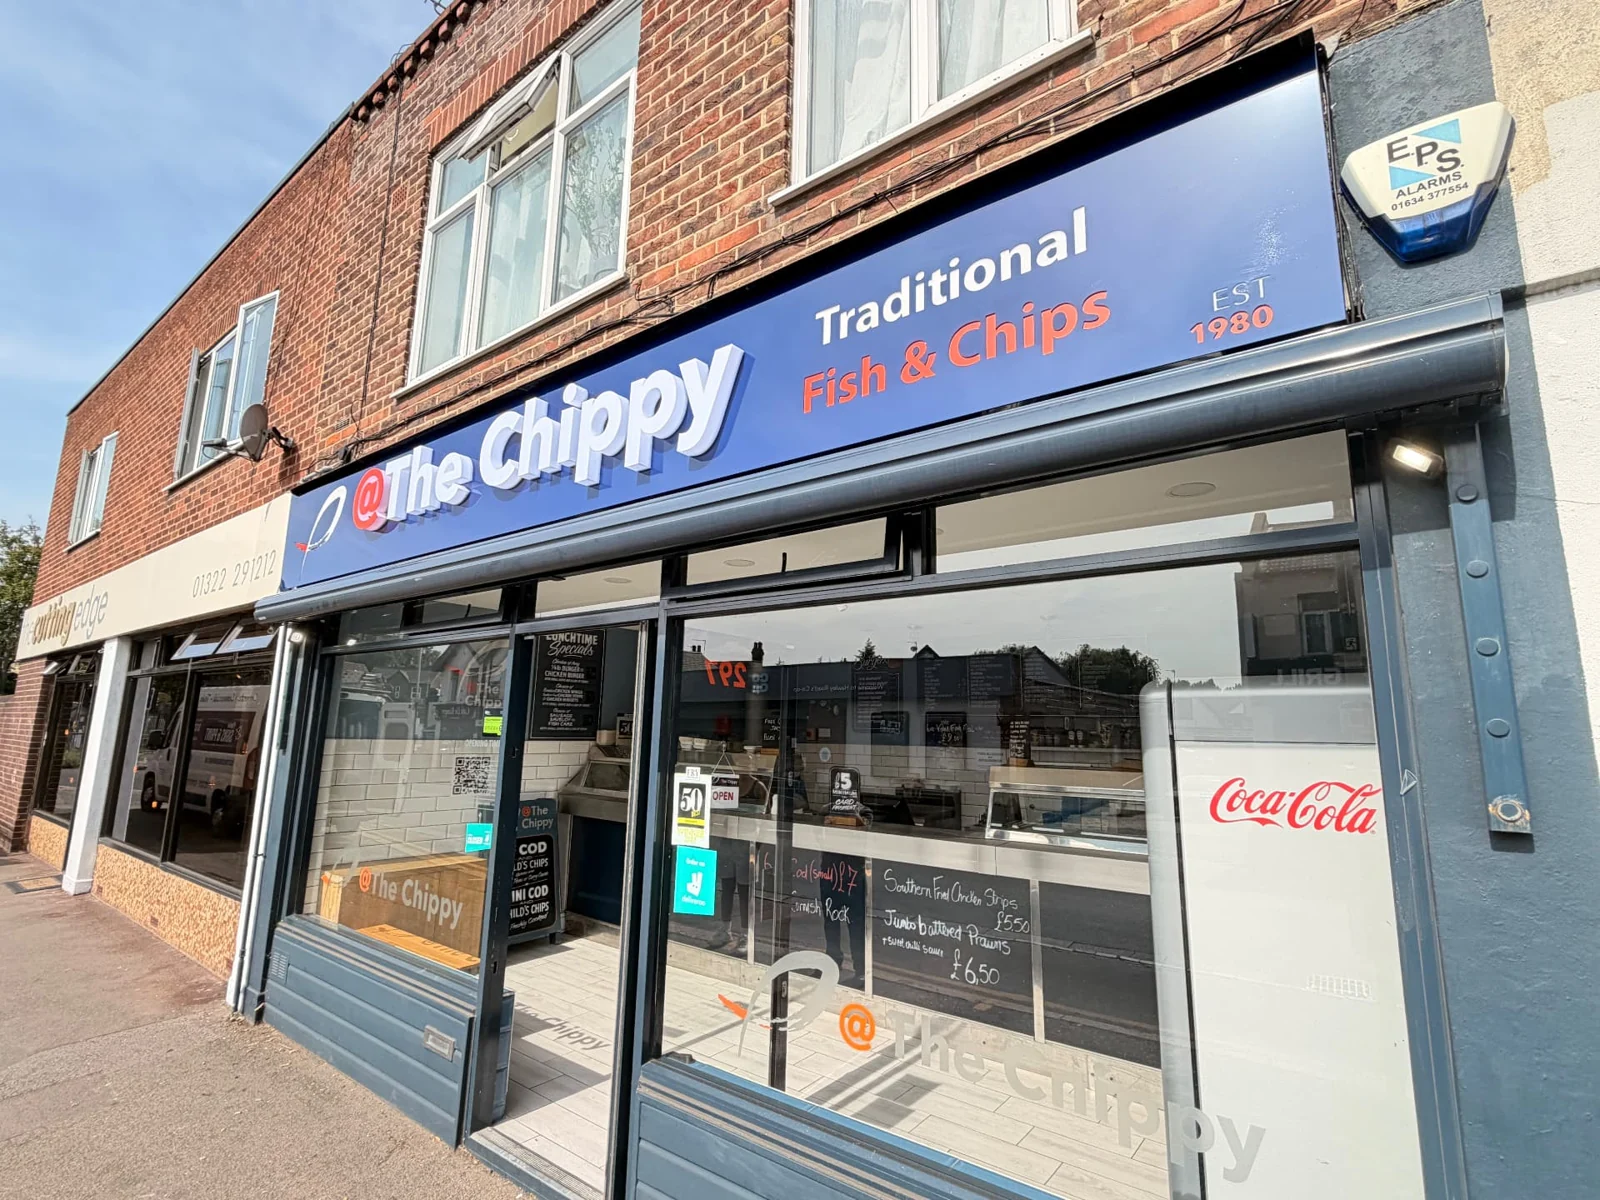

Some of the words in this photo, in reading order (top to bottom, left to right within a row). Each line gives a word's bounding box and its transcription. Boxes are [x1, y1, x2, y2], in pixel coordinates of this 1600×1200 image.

[1390, 194, 1426, 212] 01634
[1426, 181, 1470, 202] 377554
[1395, 170, 1463, 200] ALARMS
[815, 205, 1088, 346] Traditional
[1212, 275, 1273, 313] EST
[1189, 303, 1275, 345] 1980
[802, 354, 887, 415] Fish
[899, 339, 937, 385] &
[947, 289, 1112, 368] Chips
[479, 343, 746, 489] Chippy
[192, 567, 227, 598] 01322
[231, 549, 277, 588] 291212
[32, 595, 77, 647] cutting
[73, 583, 109, 640] edge
[545, 632, 599, 645] LUNCHTIME
[547, 640, 594, 657] Specials
[465, 694, 503, 709] Chipp
[680, 787, 704, 812] 50
[712, 791, 735, 801] OPEN
[834, 798, 855, 806] CARD
[1209, 777, 1382, 835] Coca-Cola
[521, 818, 554, 830] Chippy
[518, 841, 548, 856] COD
[513, 860, 529, 872] LD'S
[529, 857, 549, 869] CHIPS
[401, 878, 464, 930] Chippy
[511, 888, 526, 903] INI
[527, 884, 549, 899] COD
[883, 868, 933, 900] Southern
[932, 875, 951, 901] Fried
[950, 881, 983, 907] Chicken
[983, 888, 1019, 911] Strips
[509, 904, 530, 919] HILD'S
[530, 901, 550, 915] CHIPS
[825, 897, 851, 925] Rock
[993, 911, 1031, 934] £5.50
[883, 909, 918, 932] Jumbo
[917, 914, 963, 942] battered
[965, 923, 1012, 956] Prawns
[1003, 1045, 1267, 1184] Chippy
